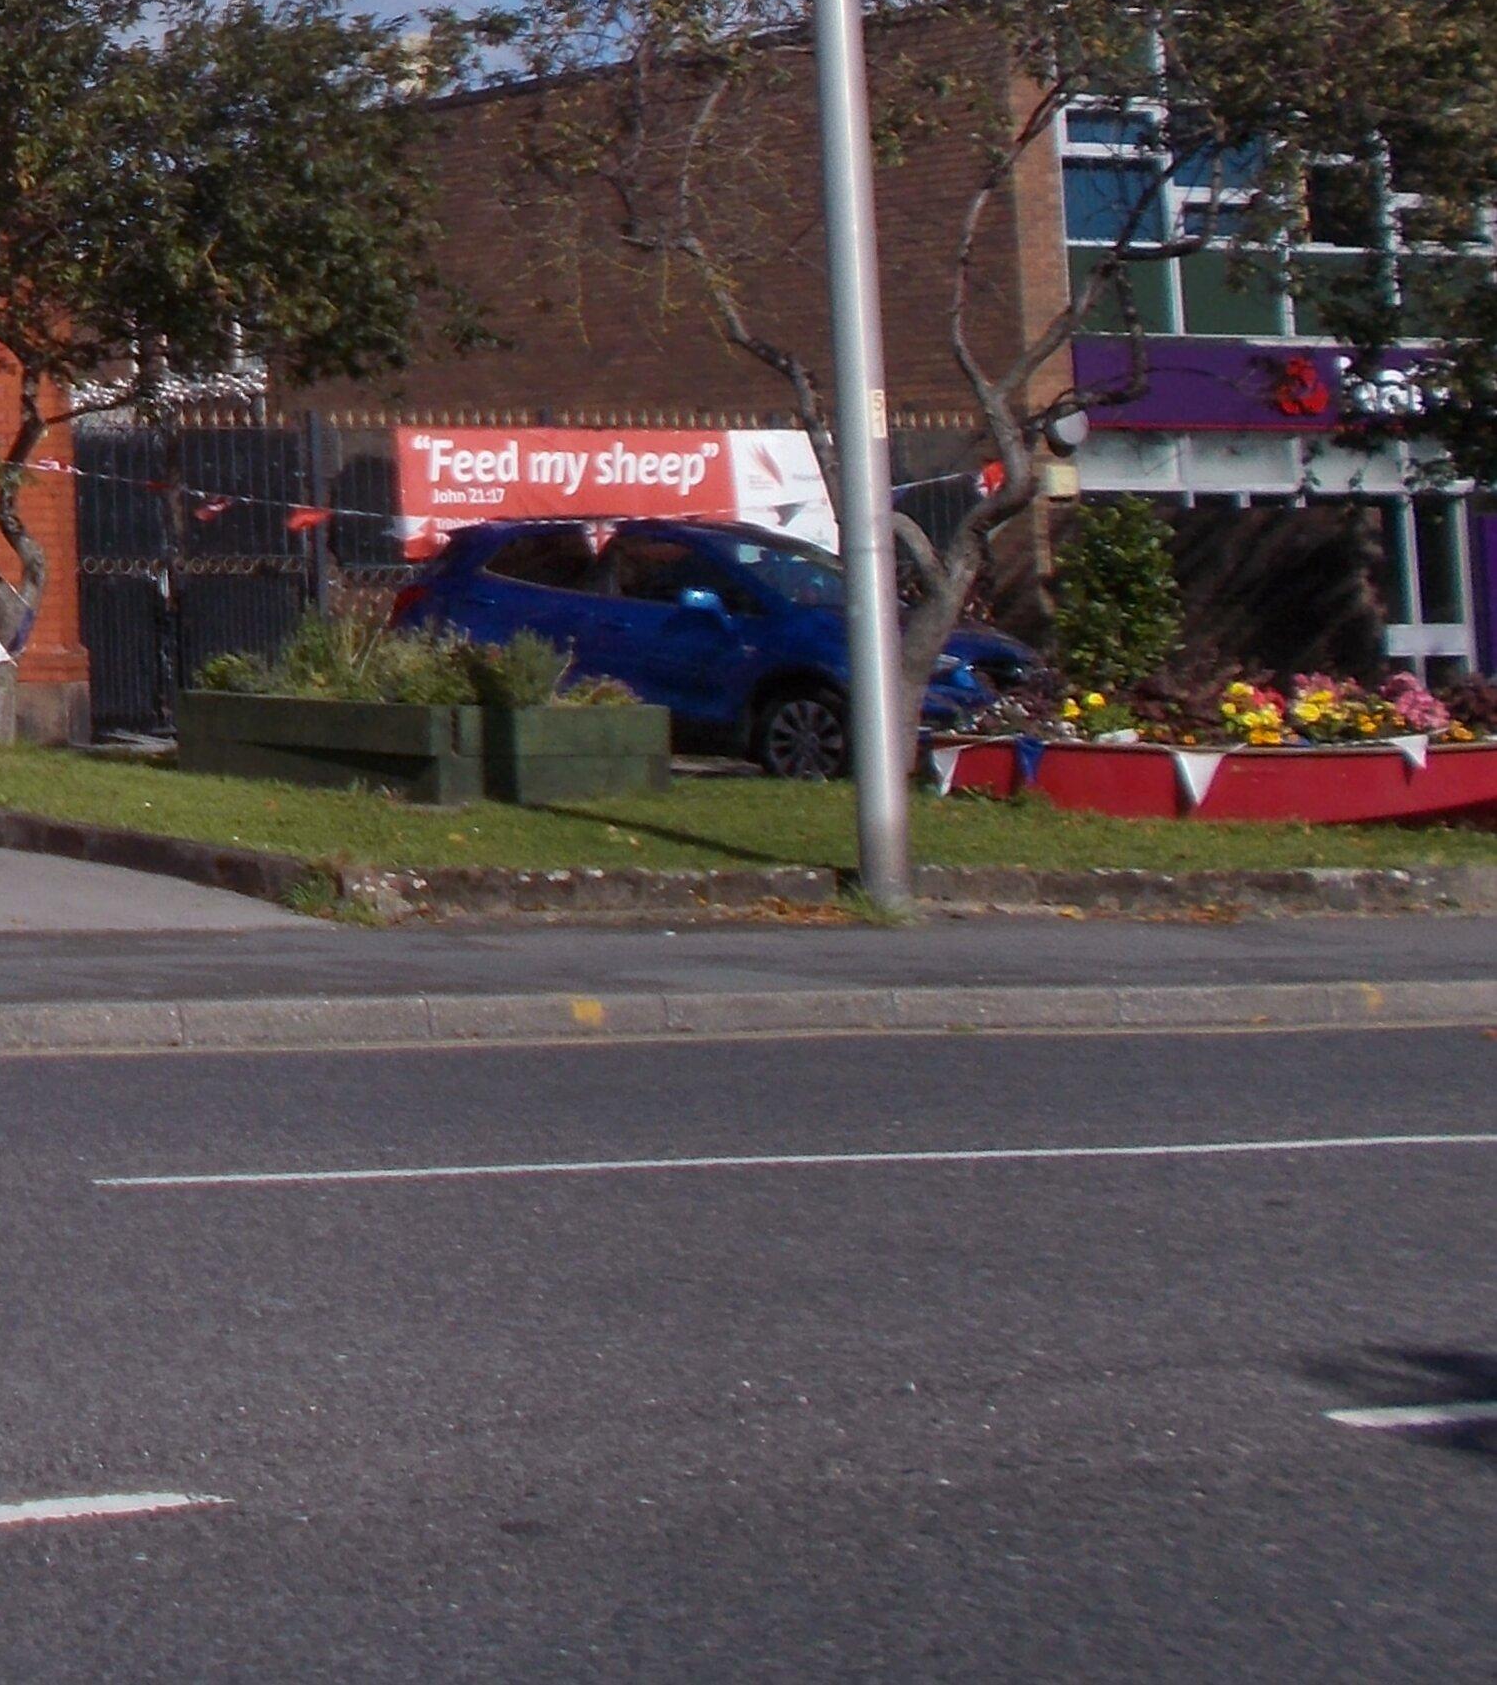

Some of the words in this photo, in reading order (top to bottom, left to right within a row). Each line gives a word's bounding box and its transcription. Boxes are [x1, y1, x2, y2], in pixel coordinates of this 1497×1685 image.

[411, 435, 520, 483] “Feed
[529, 450, 589, 496] my
[595, 441, 720, 496] sheep”
[432, 488, 467, 504] John
[468, 487, 505, 504] 21:17
